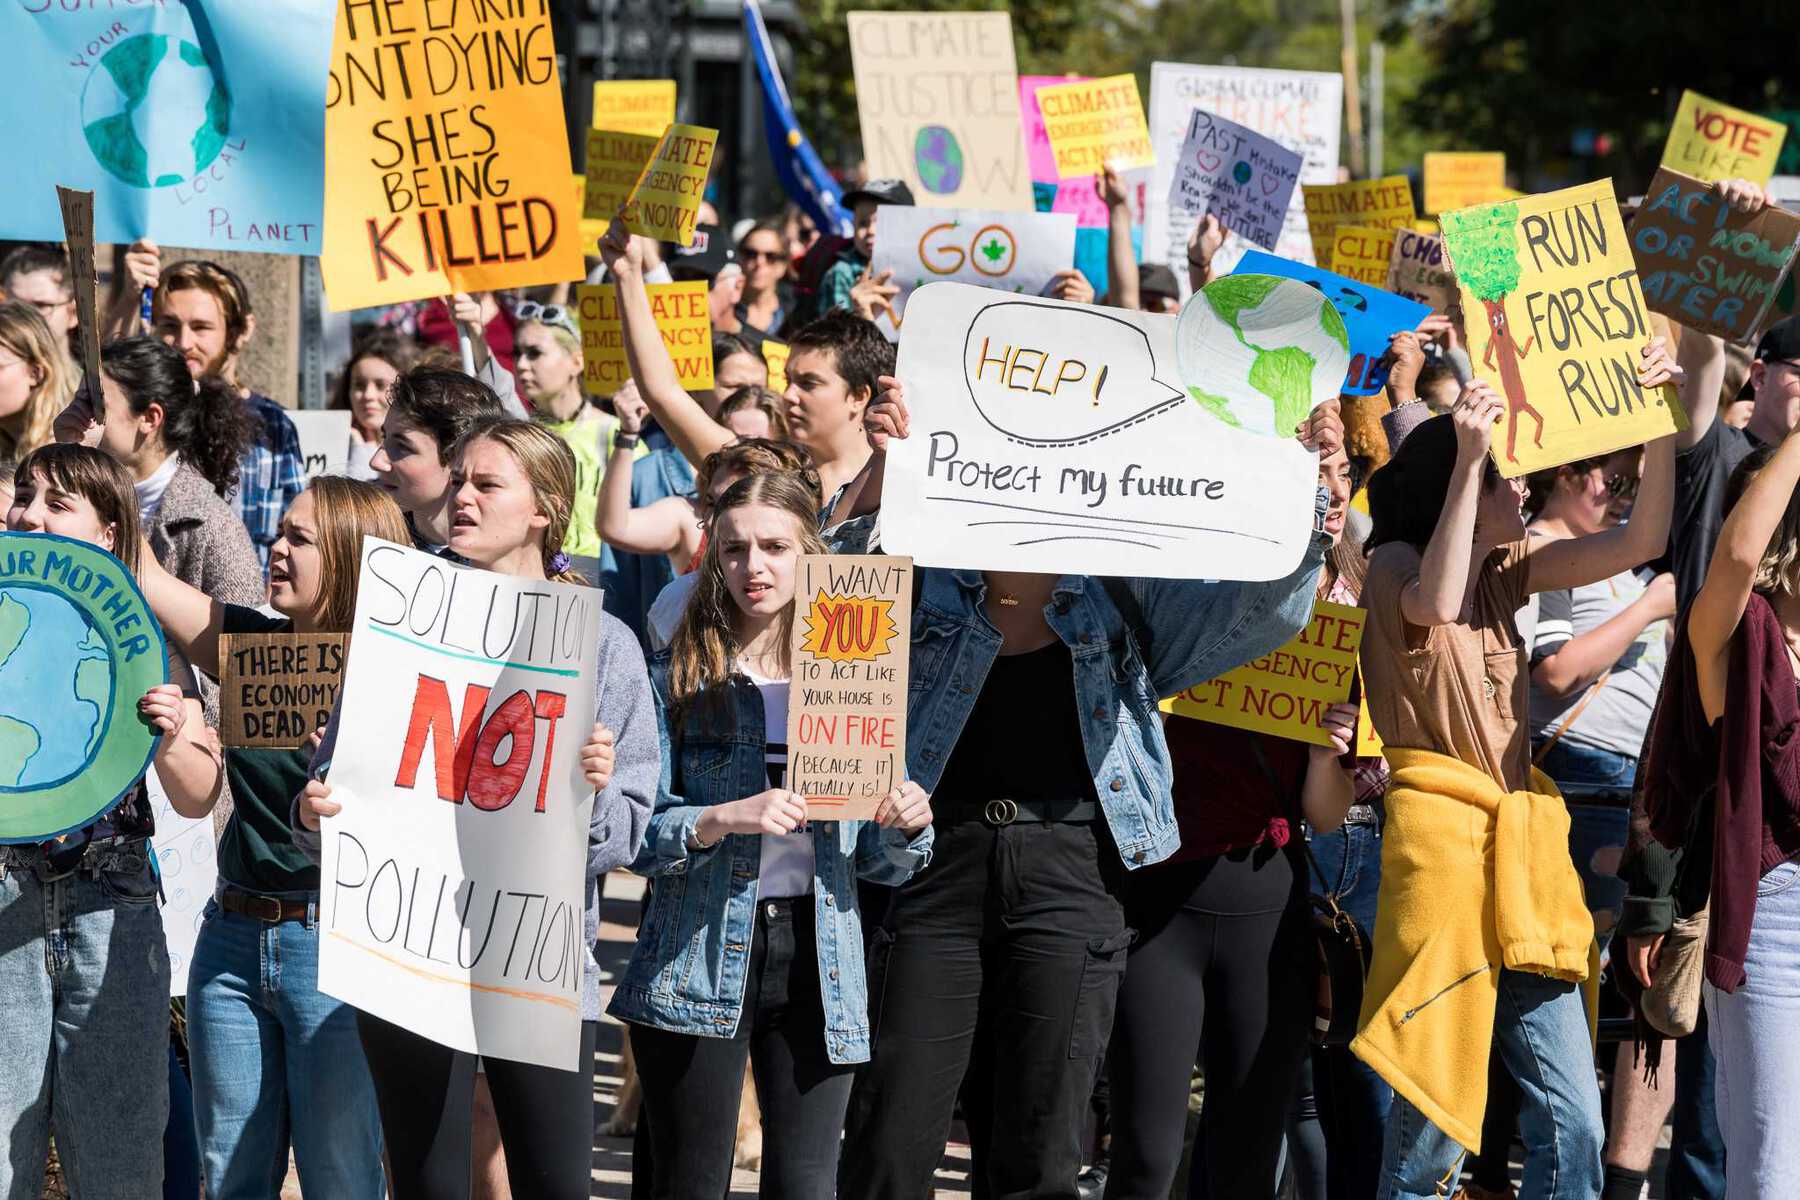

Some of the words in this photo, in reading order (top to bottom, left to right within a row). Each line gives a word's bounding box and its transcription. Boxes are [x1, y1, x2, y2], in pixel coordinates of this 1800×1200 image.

[70, 21, 129, 69] YOUR
[423, 24, 553, 96] DYING
[863, 70, 1018, 119] JUSTICE
[1041, 84, 1139, 117] CLIMATE
[1191, 110, 1247, 156] PAST
[1694, 104, 1772, 157] VOTE
[175, 137, 248, 205] LOCAL
[1057, 146, 1088, 169] ACT
[1683, 141, 1745, 176] LIKE
[382, 152, 510, 214] BEING
[1304, 185, 1411, 215] CLIMATE
[208, 207, 317, 244] PLANET
[366, 196, 559, 283] KILLED
[643, 202, 697, 233] NOW!
[1218, 206, 1273, 249] FUTURE
[1521, 199, 1608, 273] RUN
[1648, 182, 1729, 230] ACT
[1709, 228, 1793, 270] NOW
[918, 220, 1017, 277] GO
[1634, 225, 1696, 262] OR
[1690, 255, 1776, 304] SWIM
[580, 293, 706, 321] CLIATE
[1525, 269, 1647, 353] FOREST
[586, 360, 625, 382] ACT
[673, 355, 712, 379] W!
[976, 335, 1109, 407] HELP!
[1557, 352, 1664, 425] RUN!
[927, 430, 1042, 494] Protect
[1059, 466, 1108, 509] my
[1118, 463, 1225, 501] future
[806, 562, 812, 596] I
[828, 562, 907, 595] WANT
[41, 550, 151, 664] MOTHER
[817, 601, 880, 653] YOU
[233, 644, 309, 677] THERE
[316, 642, 344, 674] IS
[798, 659, 822, 681] TO
[830, 664, 860, 681] ACT
[866, 664, 897, 682] LIKE
[1244, 651, 1352, 687] GENCY
[241, 683, 340, 708] ECONOMY
[802, 688, 835, 706] YOUR
[838, 689, 874, 706] HOUSE
[882, 692, 894, 706] IS
[242, 710, 306, 739] DEAD
[393, 672, 568, 814] NOT
[798, 713, 838, 745] ON
[845, 714, 896, 749] FIRE
[799, 779, 855, 797] ACTUALLY
[861, 779, 880, 798] IS!
[331, 831, 583, 993] POLLUTION
